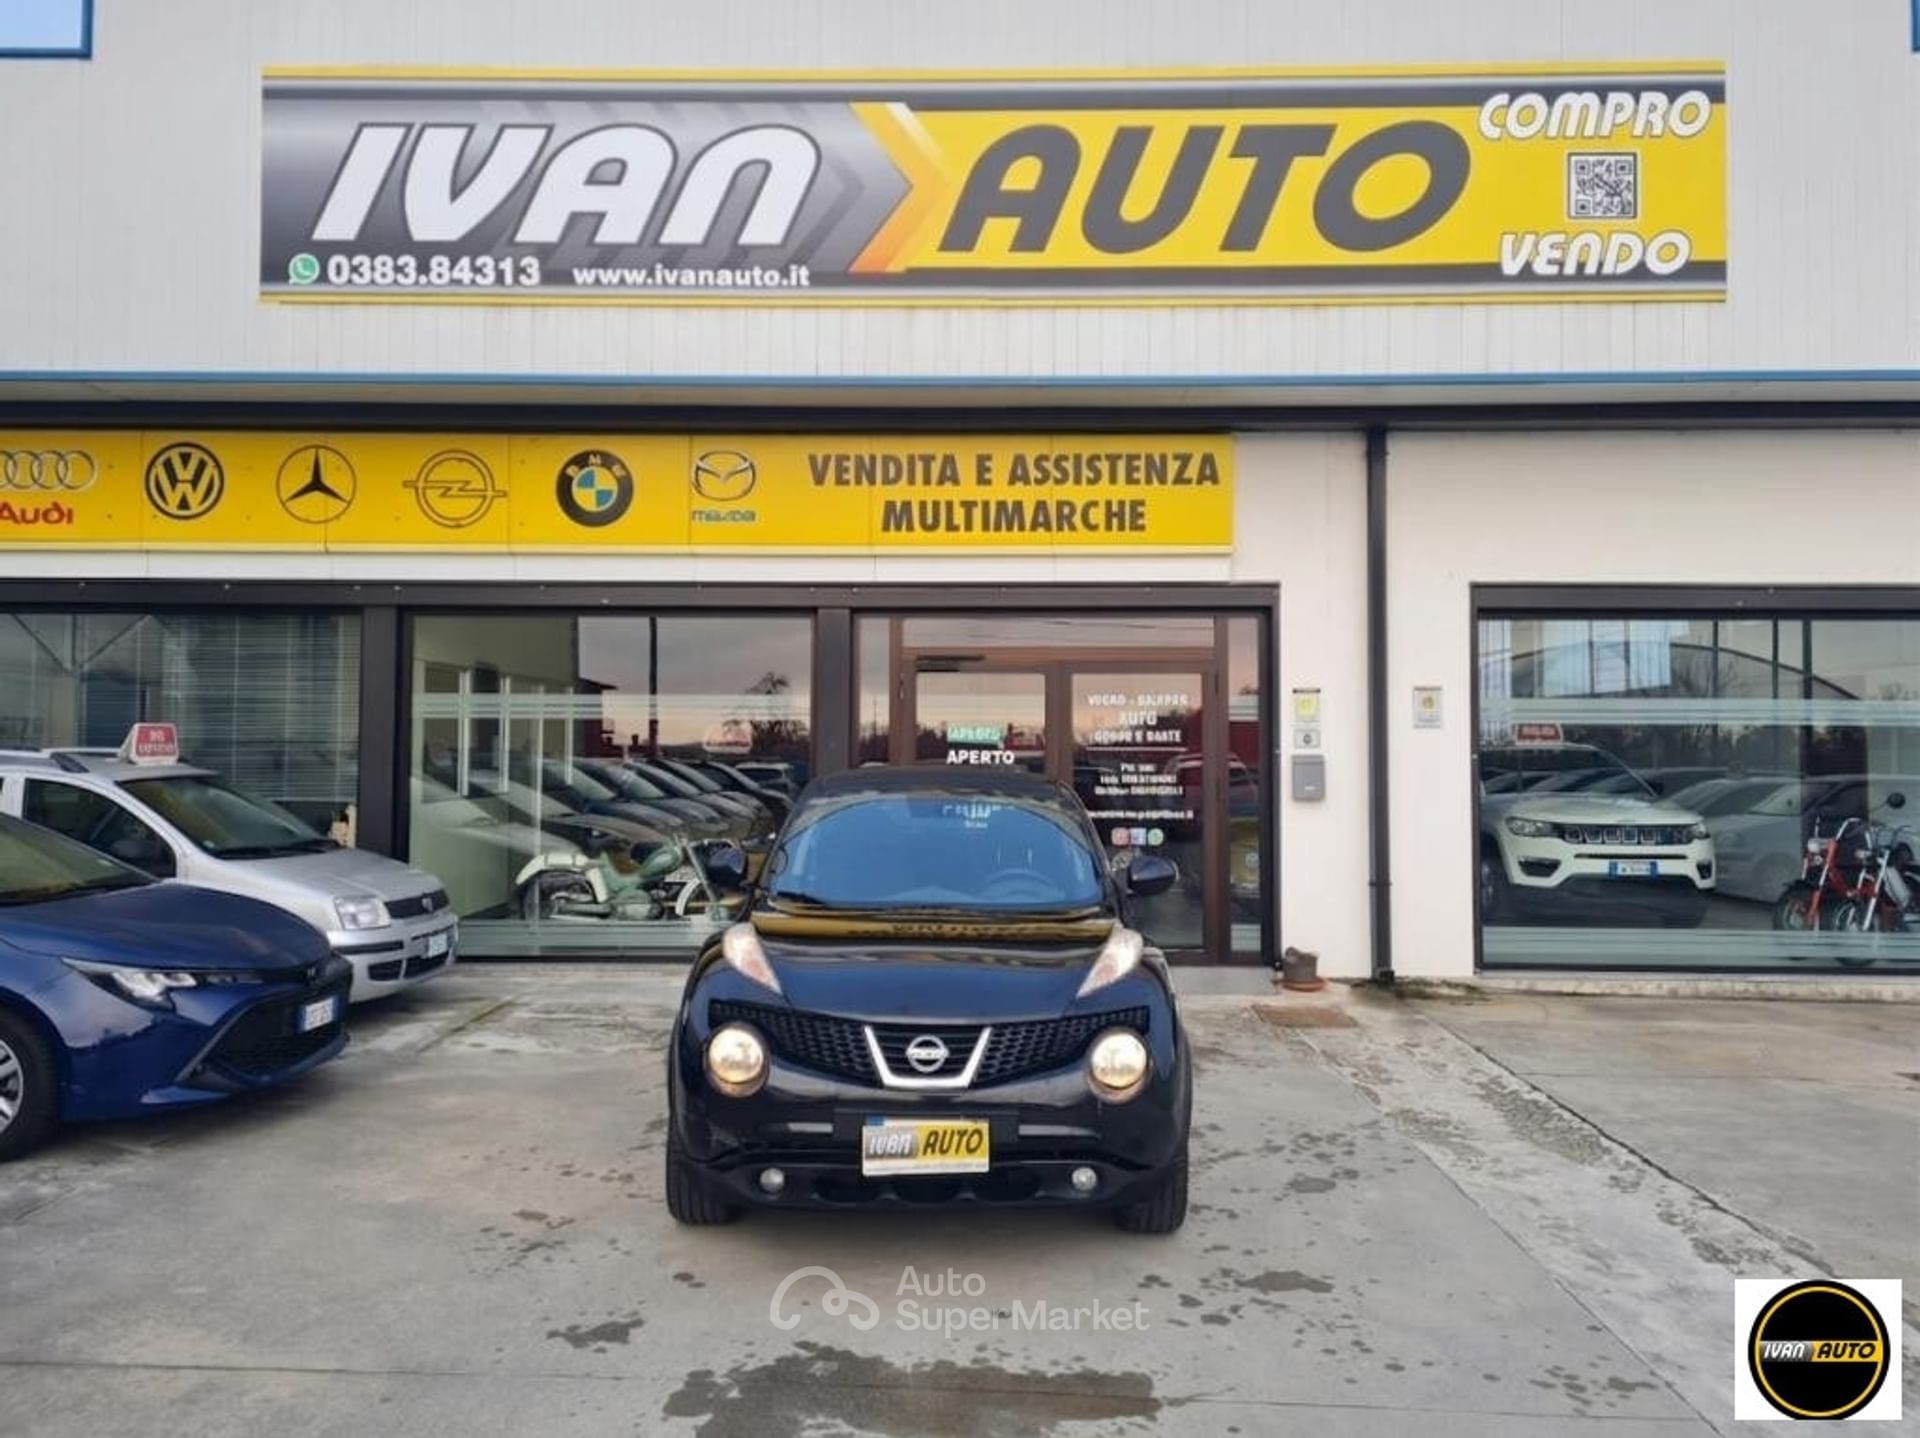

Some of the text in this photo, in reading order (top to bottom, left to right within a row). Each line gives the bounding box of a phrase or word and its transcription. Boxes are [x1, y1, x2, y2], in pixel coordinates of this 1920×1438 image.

[1478, 91, 1711, 141] COMPRO
[310, 120, 1471, 255] IVAN AUTO
[1499, 231, 1692, 277] VENDO
[328, 256, 541, 287] 0383.84313
[572, 261, 811, 288] www.ivanauto.it
[808, 452, 1220, 487] VENDITA E ASSISTENZA
[0, 501, 74, 524] Audi
[881, 499, 1147, 533] MULTIMARCHE
[947, 749, 1015, 765] APERTO
[922, 1127, 984, 1157] AUTO
